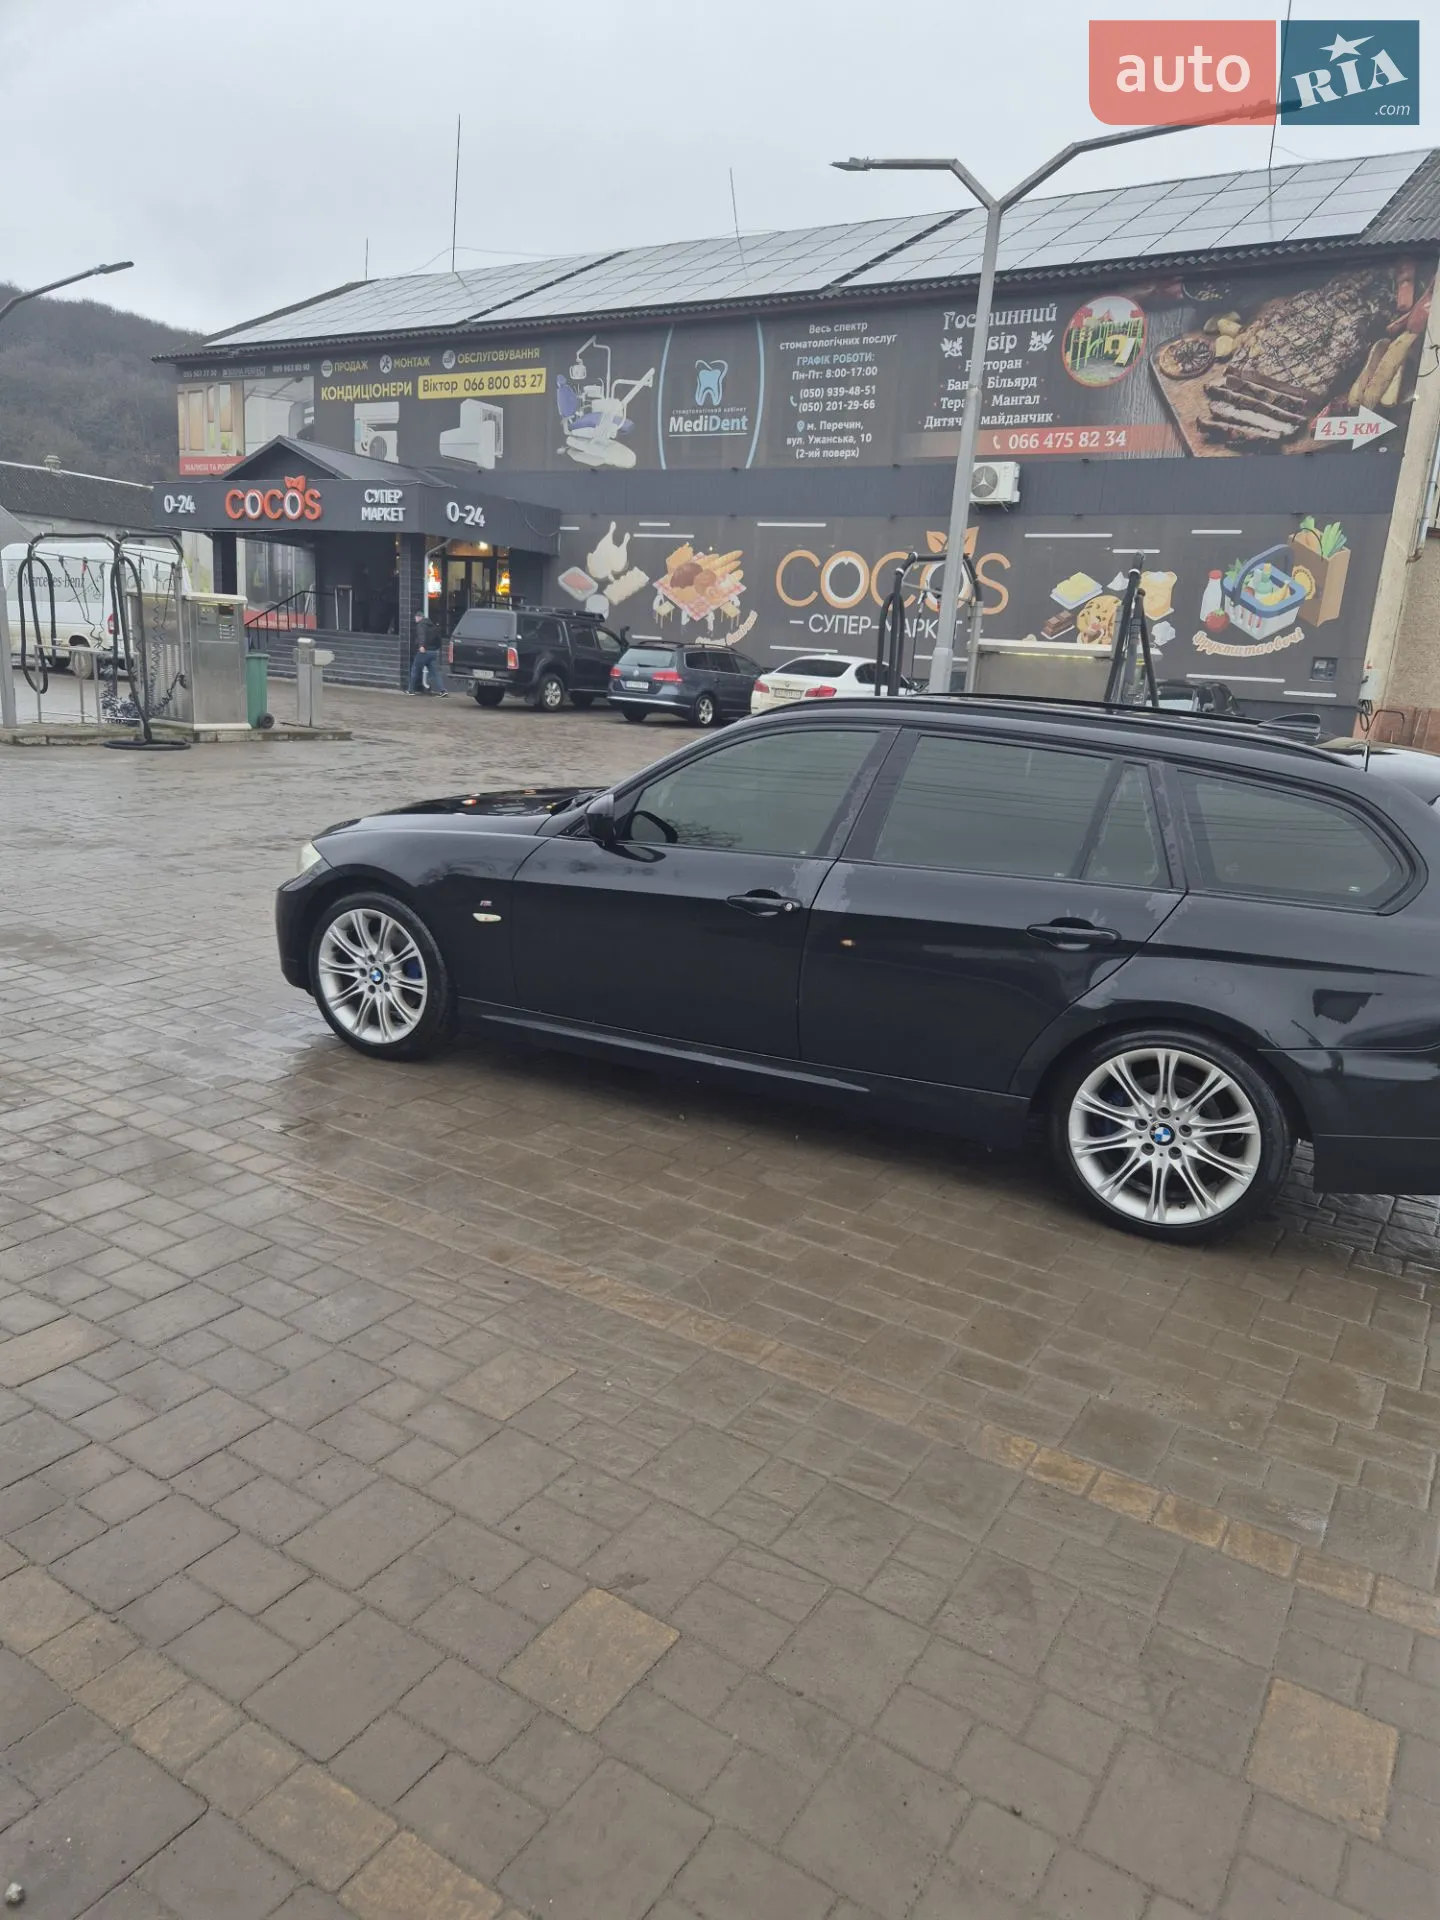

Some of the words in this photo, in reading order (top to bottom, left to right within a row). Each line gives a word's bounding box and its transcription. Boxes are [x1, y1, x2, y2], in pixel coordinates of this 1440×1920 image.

[809, 324, 832, 335] Весь
[834, 321, 868, 333] спектр
[779, 336, 860, 351] стоматологічних
[862, 333, 898, 345] послуг
[987, 331, 1018, 354] вір
[393, 356, 431, 369] МОНТАЖ
[457, 347, 541, 364] ОБСЛУГОВУВАННЯ
[796, 353, 830, 367] ГРАФІК
[833, 352, 875, 364] РОБОТИ:
[334, 360, 369, 372] ПРОДАЖ
[964, 358, 1023, 372] Рторан
[791, 368, 823, 381] Пн-Пт:
[825, 366, 878, 379] 8:00-17:00
[422, 378, 458, 395] Віктор
[463, 378, 484, 391] 066
[487, 376, 509, 390] 800
[513, 375, 527, 388] 83
[529, 373, 544, 387] 27
[987, 375, 1038, 390] Більярд
[320, 381, 413, 402] КОНДИЦІОНЕРИ
[799, 388, 825, 400] (050)
[826, 385, 876, 397] 939-48-51
[798, 401, 823, 414] (050)
[825, 399, 876, 412] 201-29-66
[991, 394, 1041, 407] Мангал
[669, 414, 749, 433] MediDent
[806, 423, 817, 431] м.
[820, 420, 864, 432] Перечин,
[923, 414, 963, 430] Дитяч
[981, 411, 1054, 426] майданчик
[1320, 419, 1348, 437] 4.5
[786, 437, 805, 447] вул.
[808, 434, 857, 445] Ужанська,
[860, 433, 872, 442] 10
[1008, 430, 1040, 449] 066
[1042, 429, 1075, 448] 475
[1078, 429, 1100, 447] 82
[1103, 428, 1127, 447] 34
[795, 448, 820, 460] (2-ий
[822, 447, 860, 460] поверх)
[164, 494, 196, 514] 0-24
[225, 487, 323, 521] COCOS
[364, 489, 403, 504] СУПЕР
[361, 505, 406, 523] МАРКЕТ
[446, 501, 486, 527] 0-24
[775, 548, 1012, 616] COCOS
